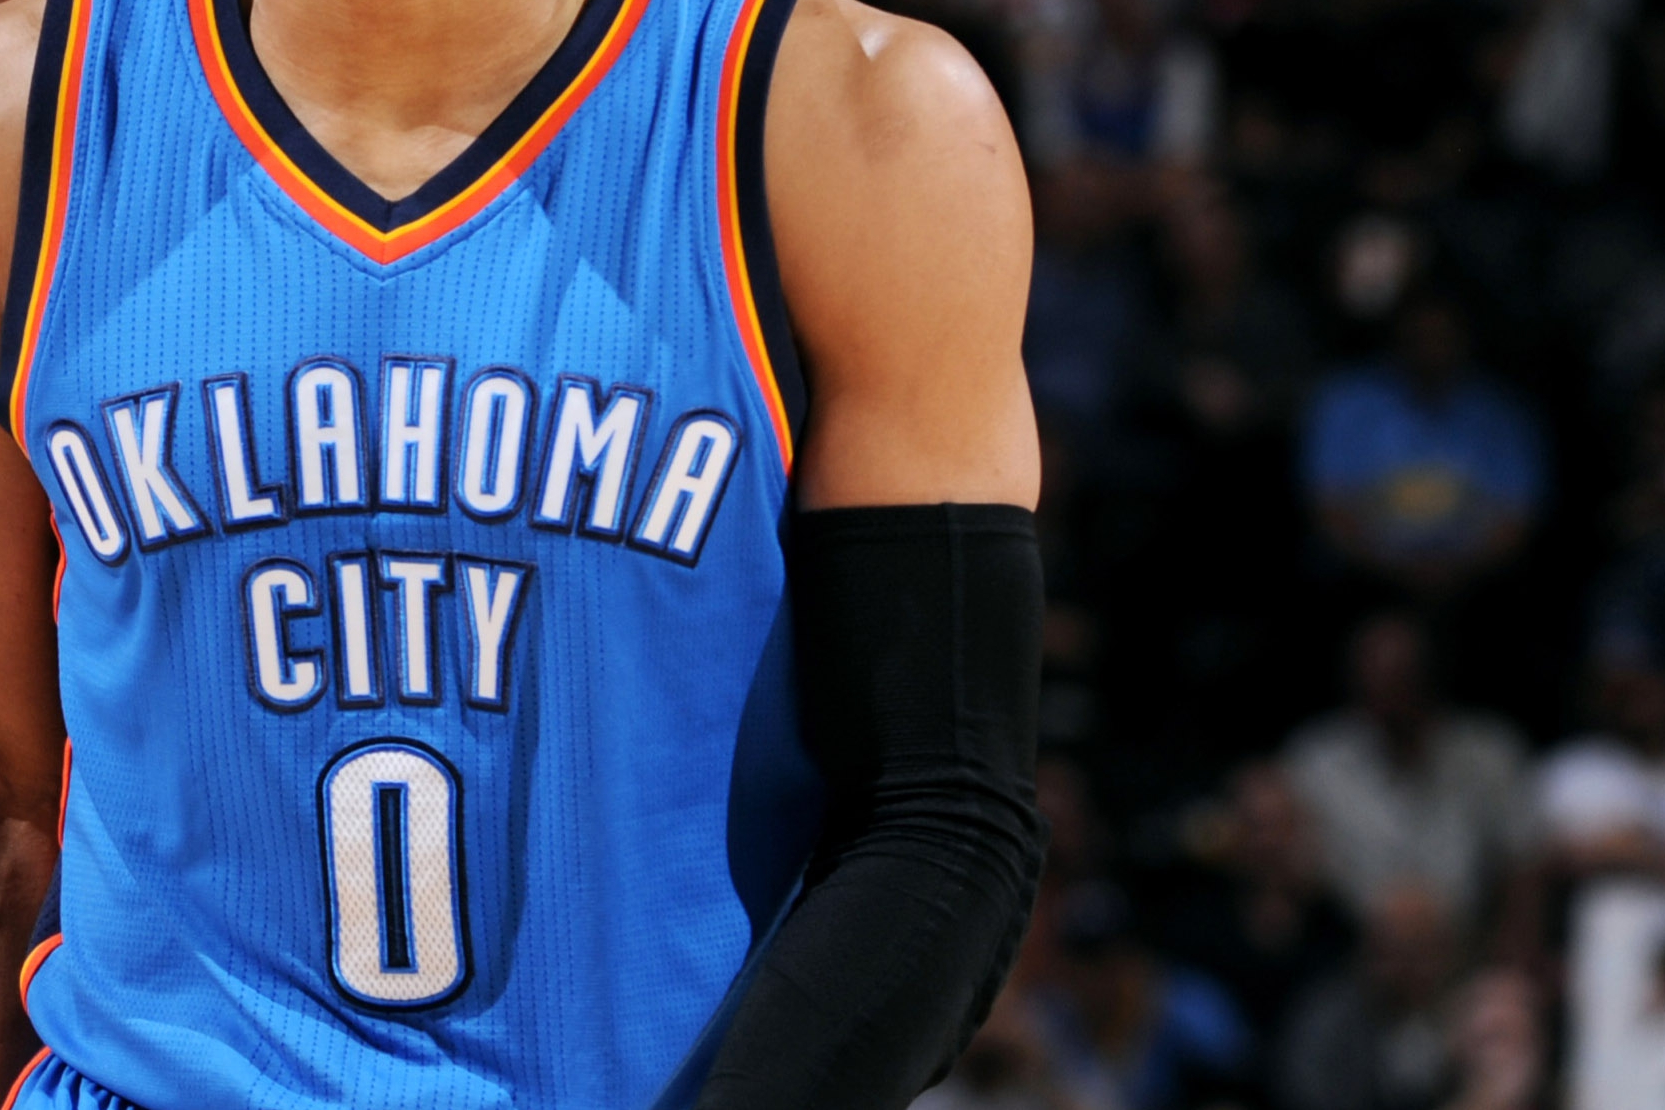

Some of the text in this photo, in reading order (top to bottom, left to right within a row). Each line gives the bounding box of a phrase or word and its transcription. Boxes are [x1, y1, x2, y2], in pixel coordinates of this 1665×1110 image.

[46, 354, 742, 567] OKLAHOMA
[243, 550, 537, 714] CITY
[316, 737, 475, 1014] 0
